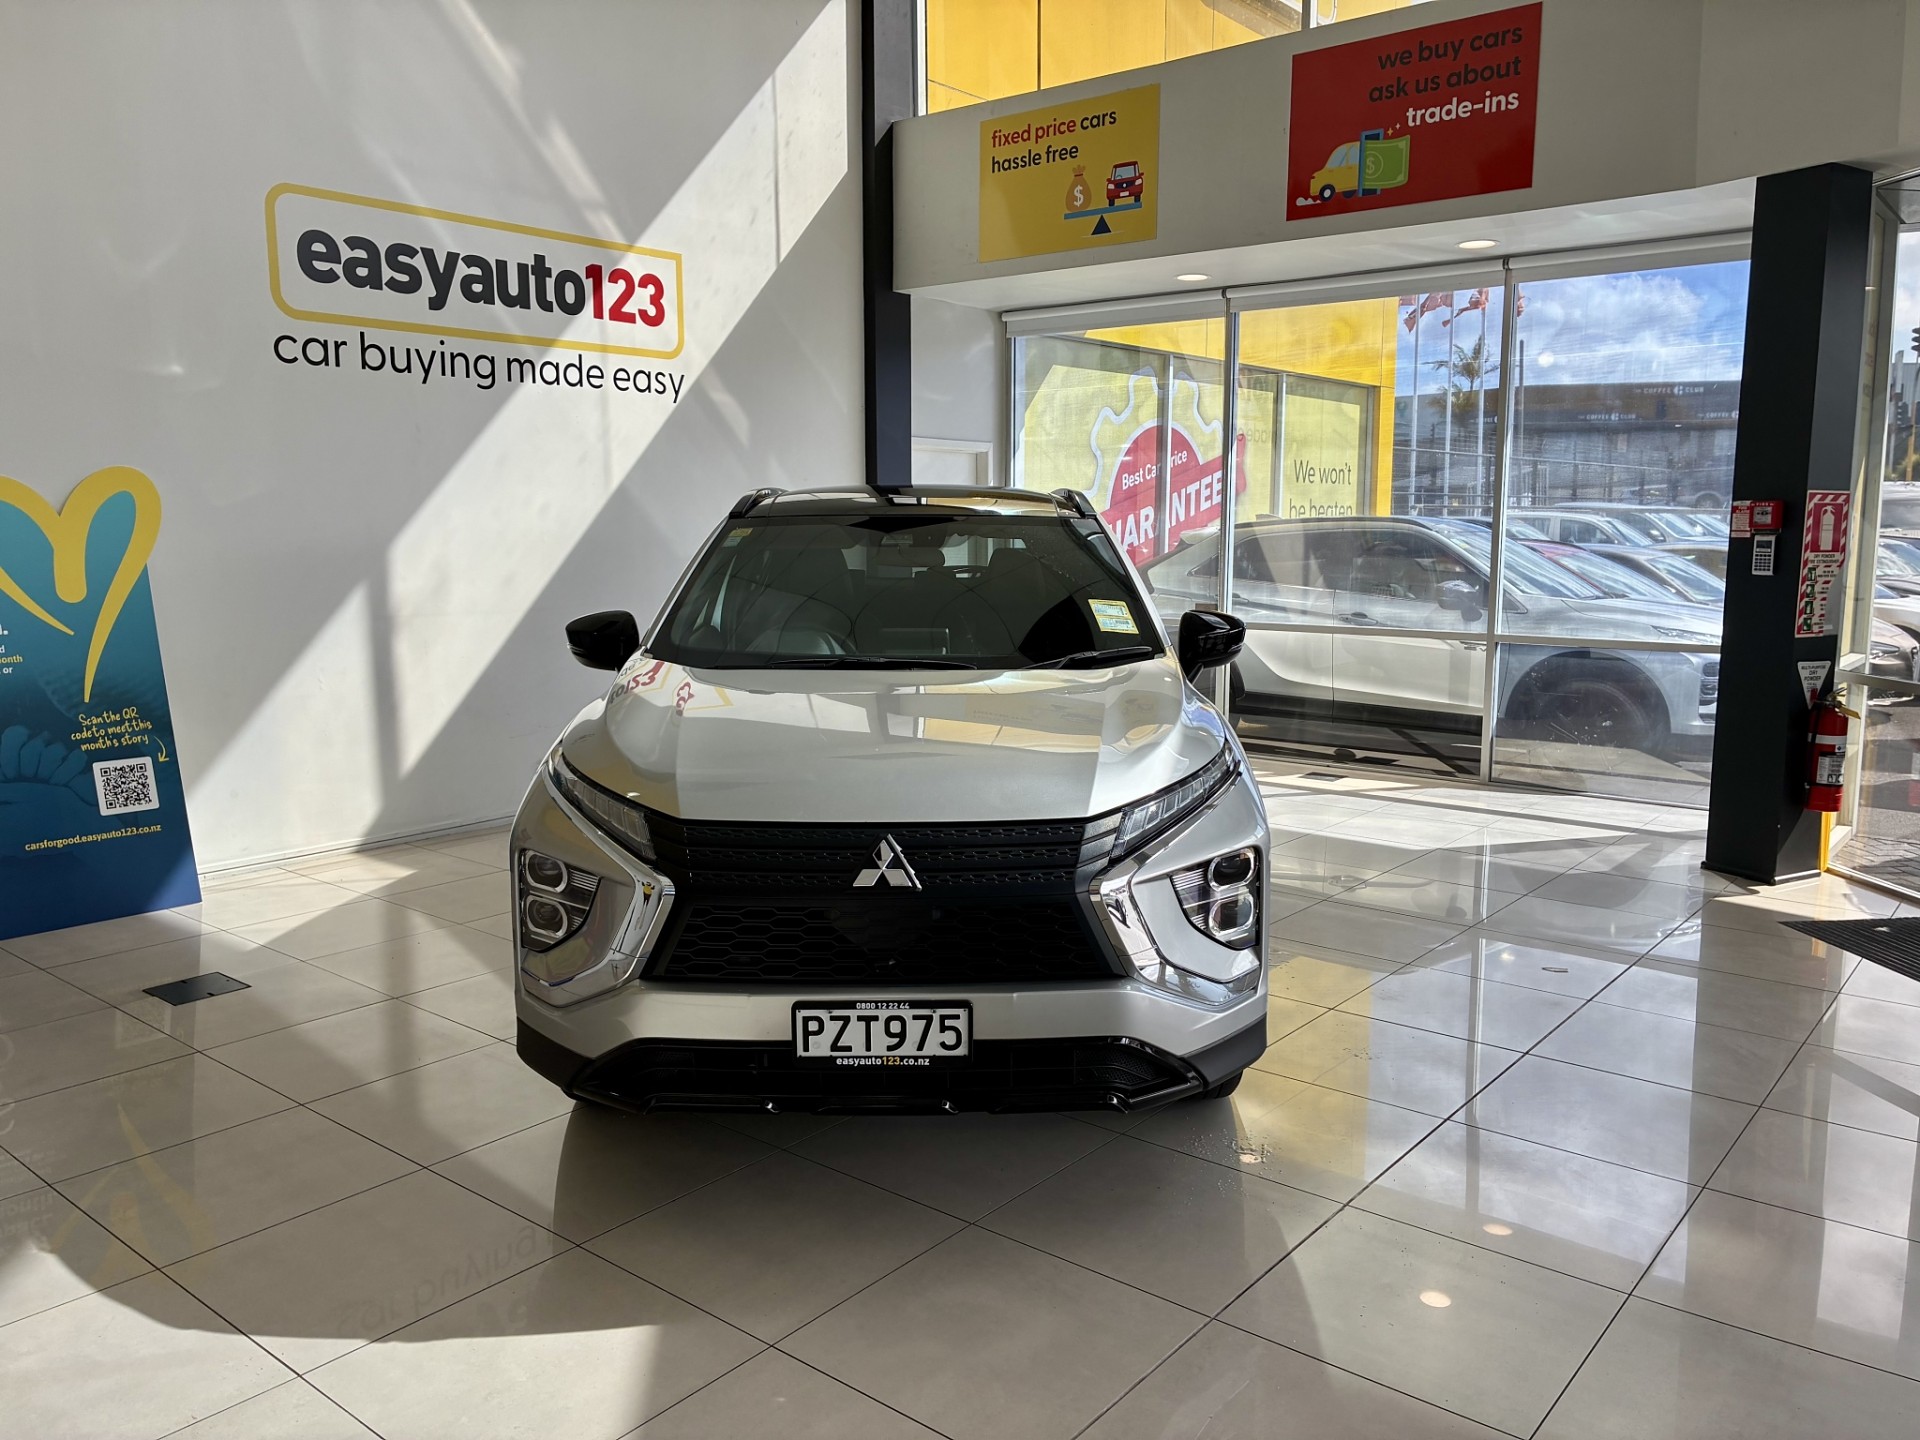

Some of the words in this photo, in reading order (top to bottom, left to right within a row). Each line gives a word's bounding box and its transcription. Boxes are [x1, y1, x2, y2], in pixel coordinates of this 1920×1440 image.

[1378, 49, 1412, 70] we
[1418, 38, 1464, 62] buy
[1470, 27, 1522, 51] cars
[1369, 77, 1408, 102] ask
[1415, 75, 1440, 94] us
[1447, 56, 1521, 88] about
[1406, 90, 1519, 127] trade-ins
[992, 124, 1031, 148] fixed
[1035, 118, 1076, 144] price
[1080, 111, 1117, 131] cars
[992, 149, 1042, 173] hassle
[1045, 145, 1079, 163] free
[297, 229, 666, 327] easyauto123
[273, 333, 348, 367] car
[359, 331, 496, 390] buying
[506, 354, 605, 390] made
[612, 367, 685, 403] easy
[1122, 468, 1143, 490] Best
[1170, 450, 1188, 468] rice
[1294, 459, 1315, 484] We
[1318, 462, 1351, 485] won't
[1289, 498, 1306, 518] be
[0, 654, 23, 663] onth
[122, 706, 139, 719] QR
[121, 732, 149, 746] story
[25, 824, 162, 851] carsforgood.easyauto123.co.nz
[856, 1002, 876, 1010] 0800
[802, 1014, 963, 1052] PZT975
[836, 1056, 930, 1067] easyauto123.co.nz
